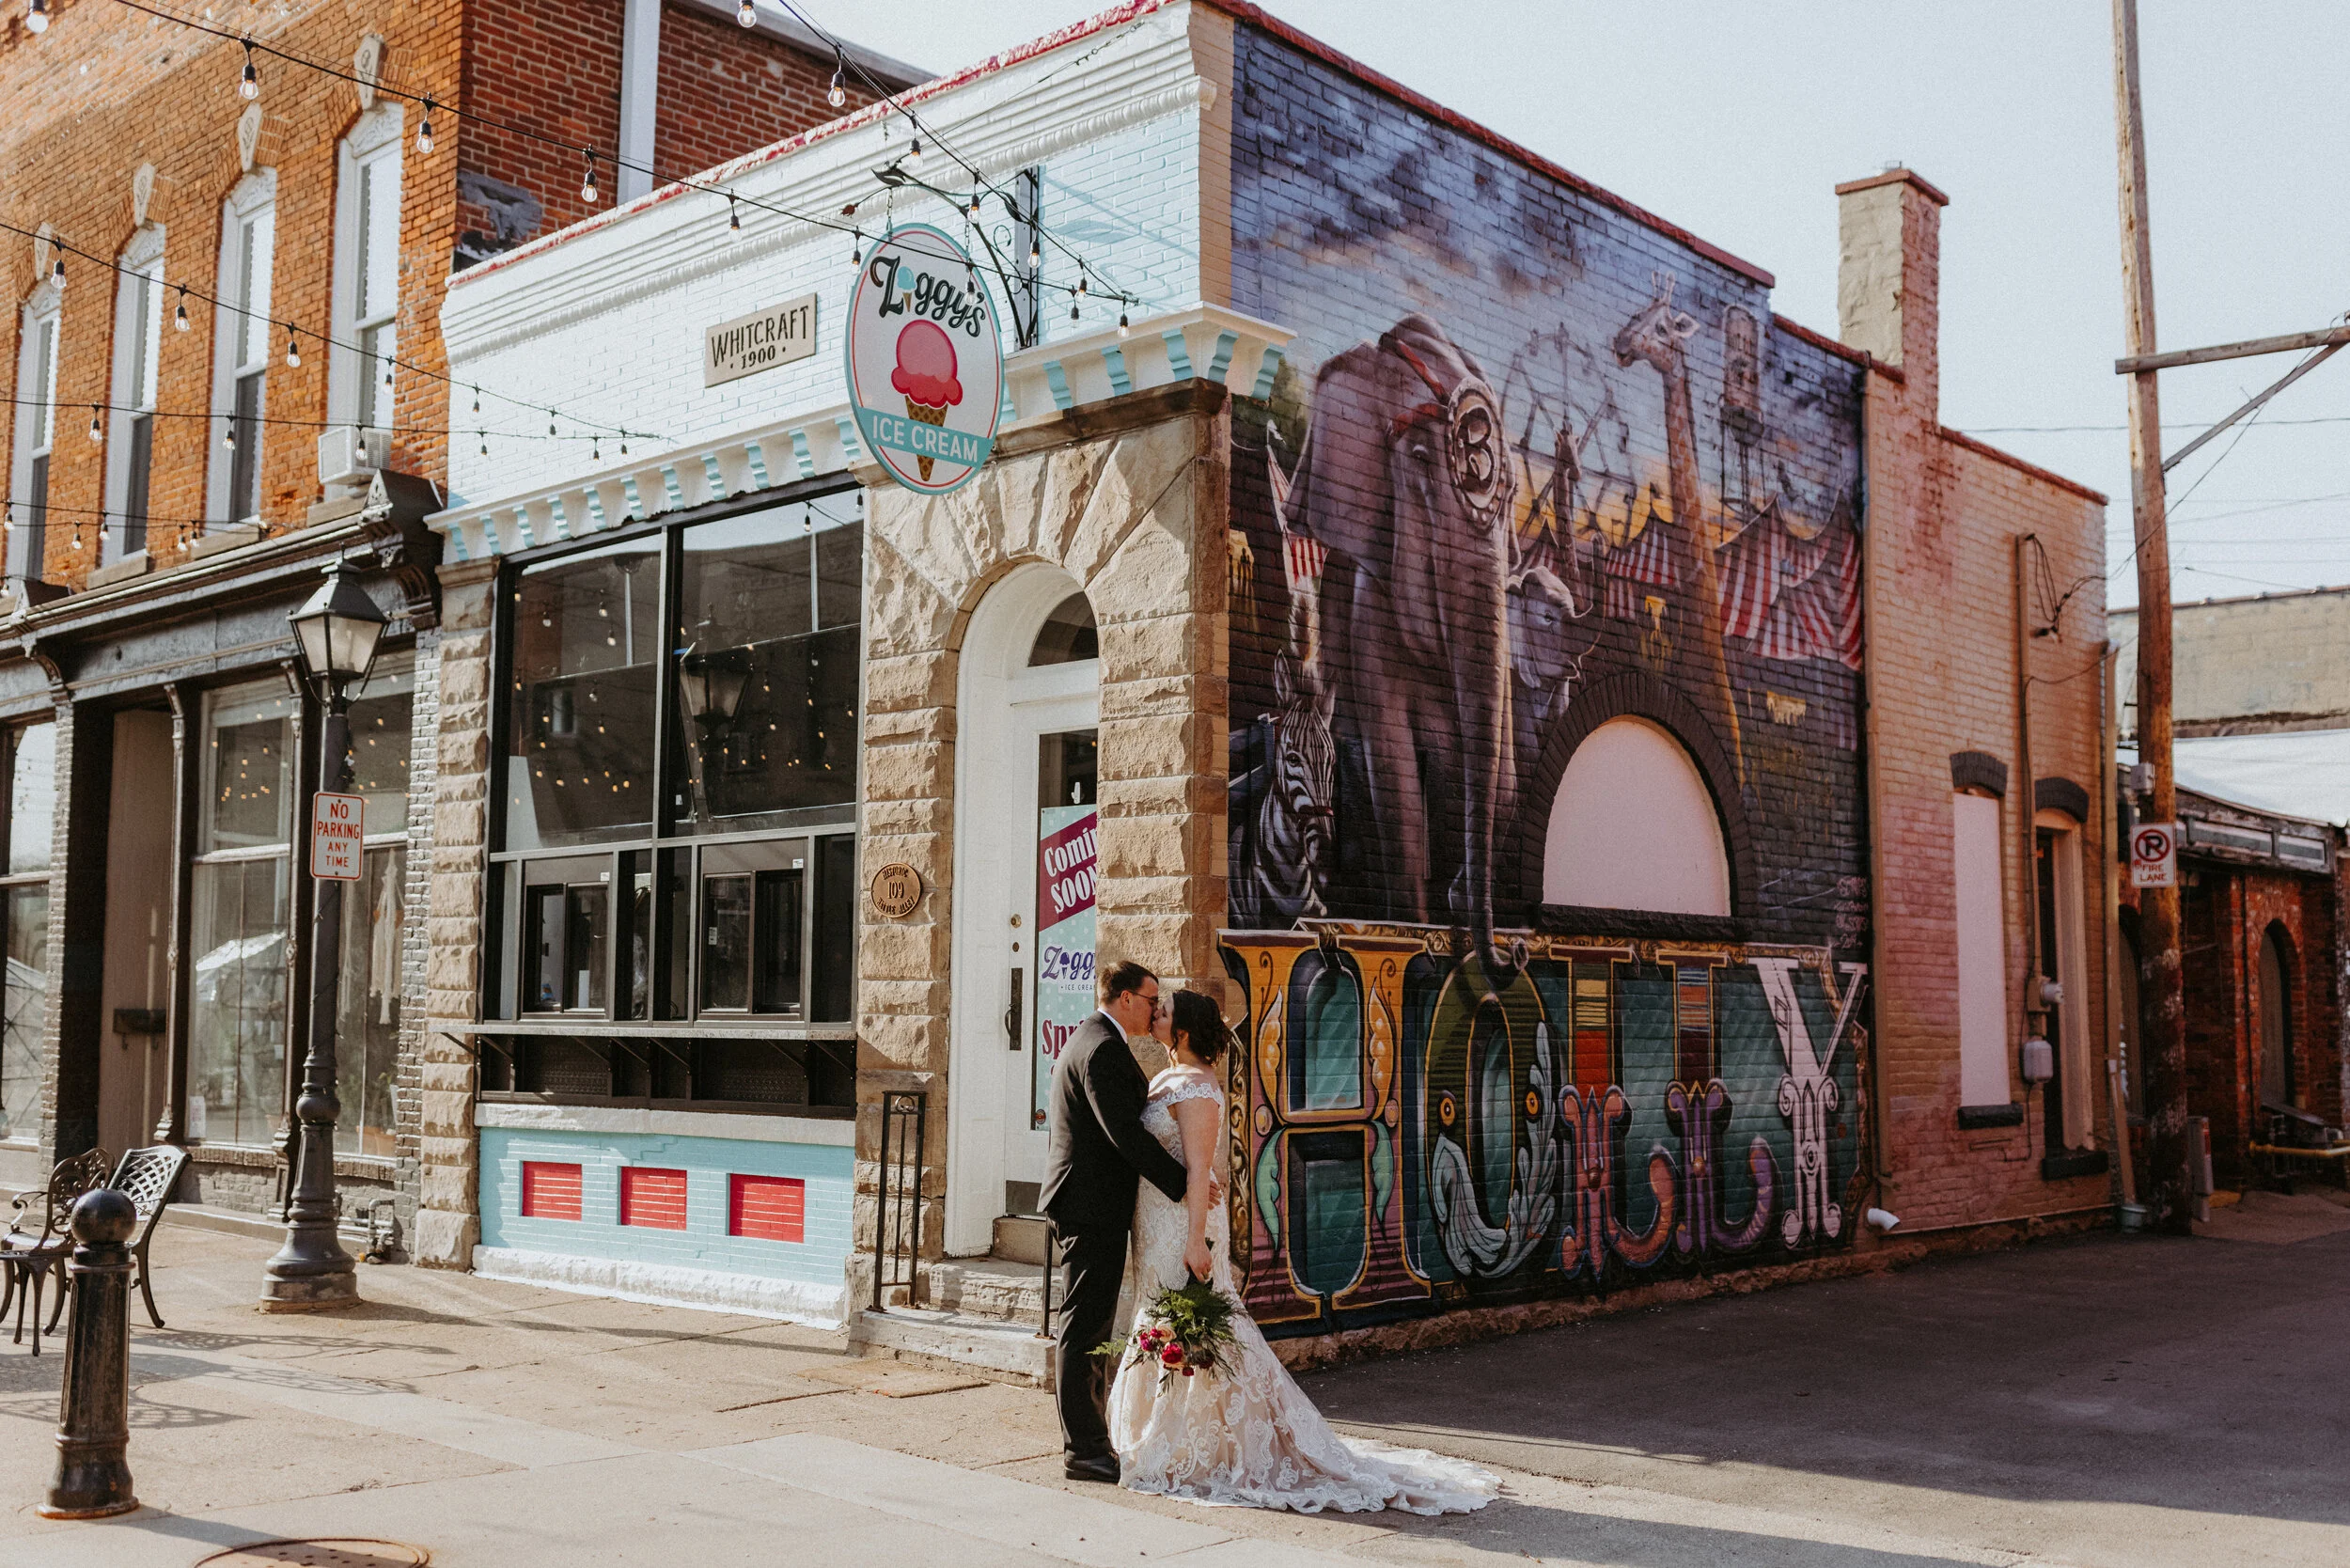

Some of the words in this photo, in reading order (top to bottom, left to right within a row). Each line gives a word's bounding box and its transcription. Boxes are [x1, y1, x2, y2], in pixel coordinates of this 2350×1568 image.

[711, 305, 809, 368] WHITCRAFT
[741, 344, 776, 370] 1900
[872, 416, 905, 446] ICE
[911, 428, 979, 463] CREAM
[330, 803, 349, 820] NO
[317, 821, 360, 839] PARKING
[327, 841, 349, 854] ANY
[325, 855, 350, 868] TIME
[2142, 864, 2164, 872] FIRE
[2139, 873, 2167, 883] LANE
[887, 881, 905, 899] 109
[1042, 946, 1097, 980] Zigg
[1215, 930, 1869, 1325] HOLLY
